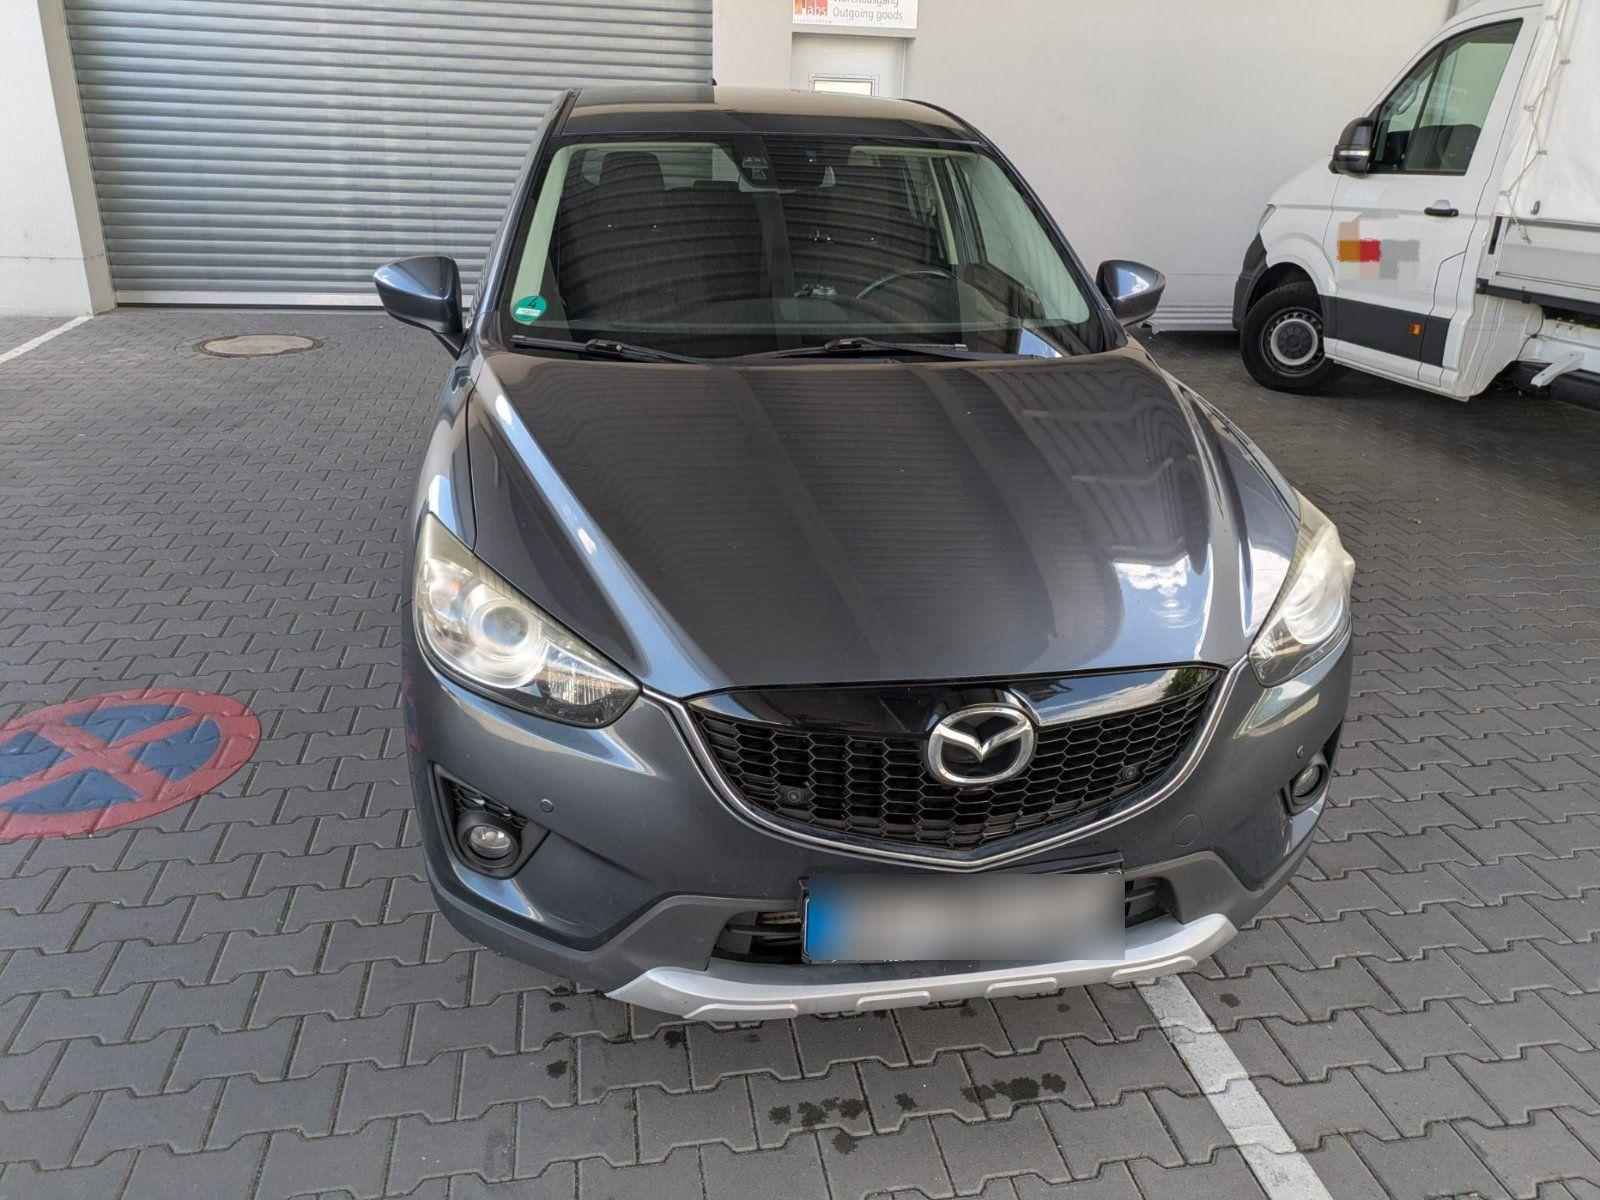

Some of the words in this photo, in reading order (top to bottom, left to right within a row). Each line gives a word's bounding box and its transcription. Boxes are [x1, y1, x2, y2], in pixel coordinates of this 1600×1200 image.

[833, 0, 899, 8] ausgang
[807, 5, 827, 16] abs
[833, 7, 873, 21] Outgoing
[876, 9, 903, 21] goods
[527, 297, 539, 309] 4
